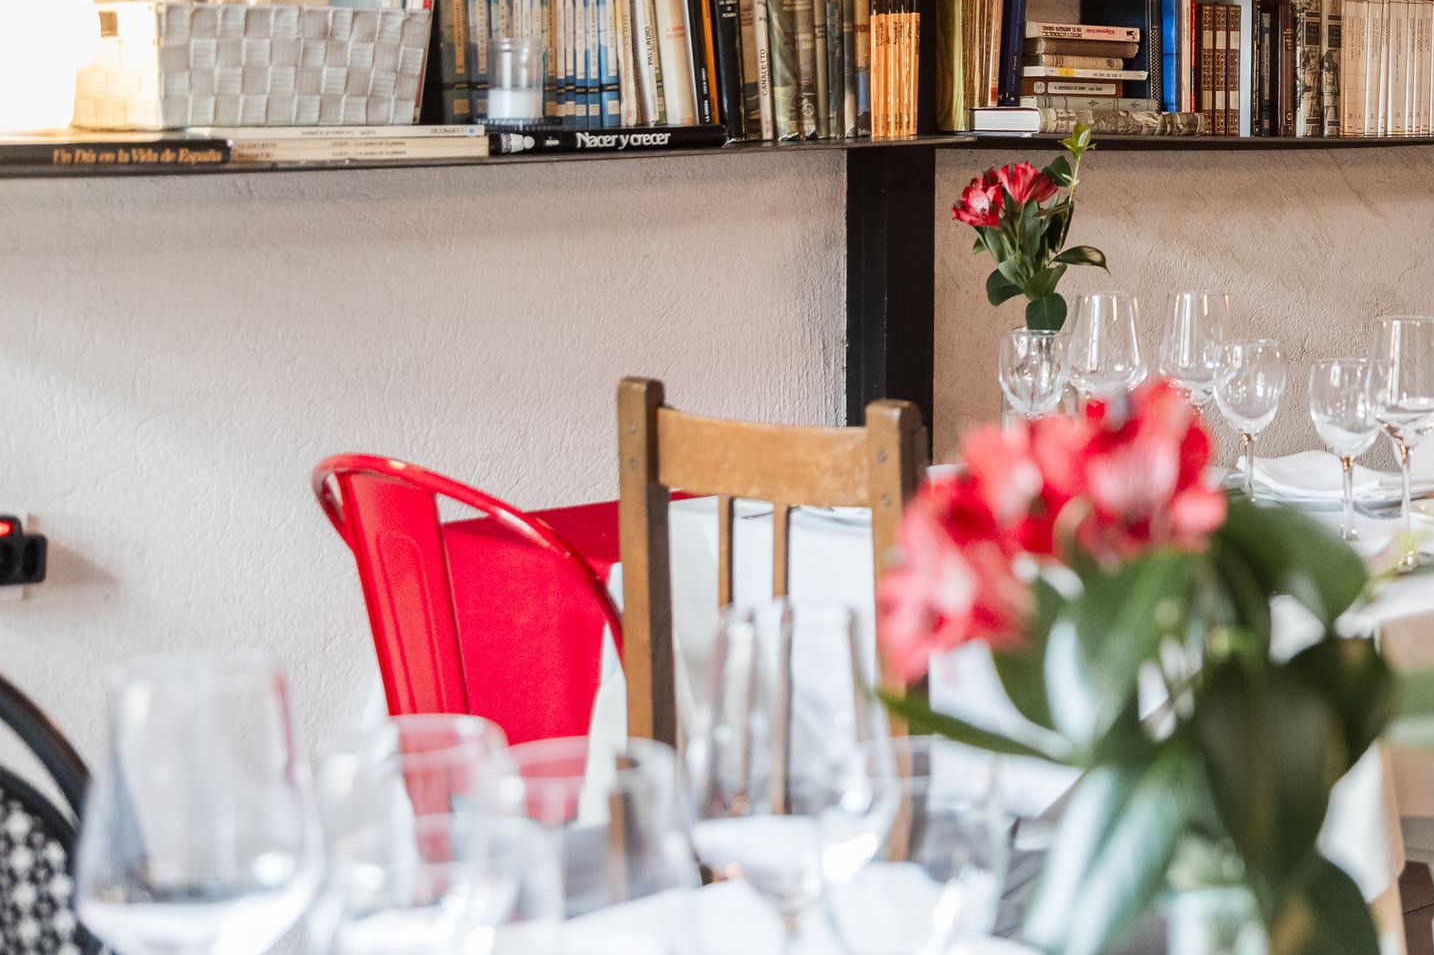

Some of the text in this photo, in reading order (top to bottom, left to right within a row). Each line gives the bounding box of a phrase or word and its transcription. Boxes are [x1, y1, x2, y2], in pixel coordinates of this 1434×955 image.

[644, 26, 654, 66] PALLADIO
[759, 48, 769, 97] CANALETTO
[575, 131, 671, 150] Nacer y crecer
[131, 147, 158, 164] Vida
[160, 148, 177, 164] de
